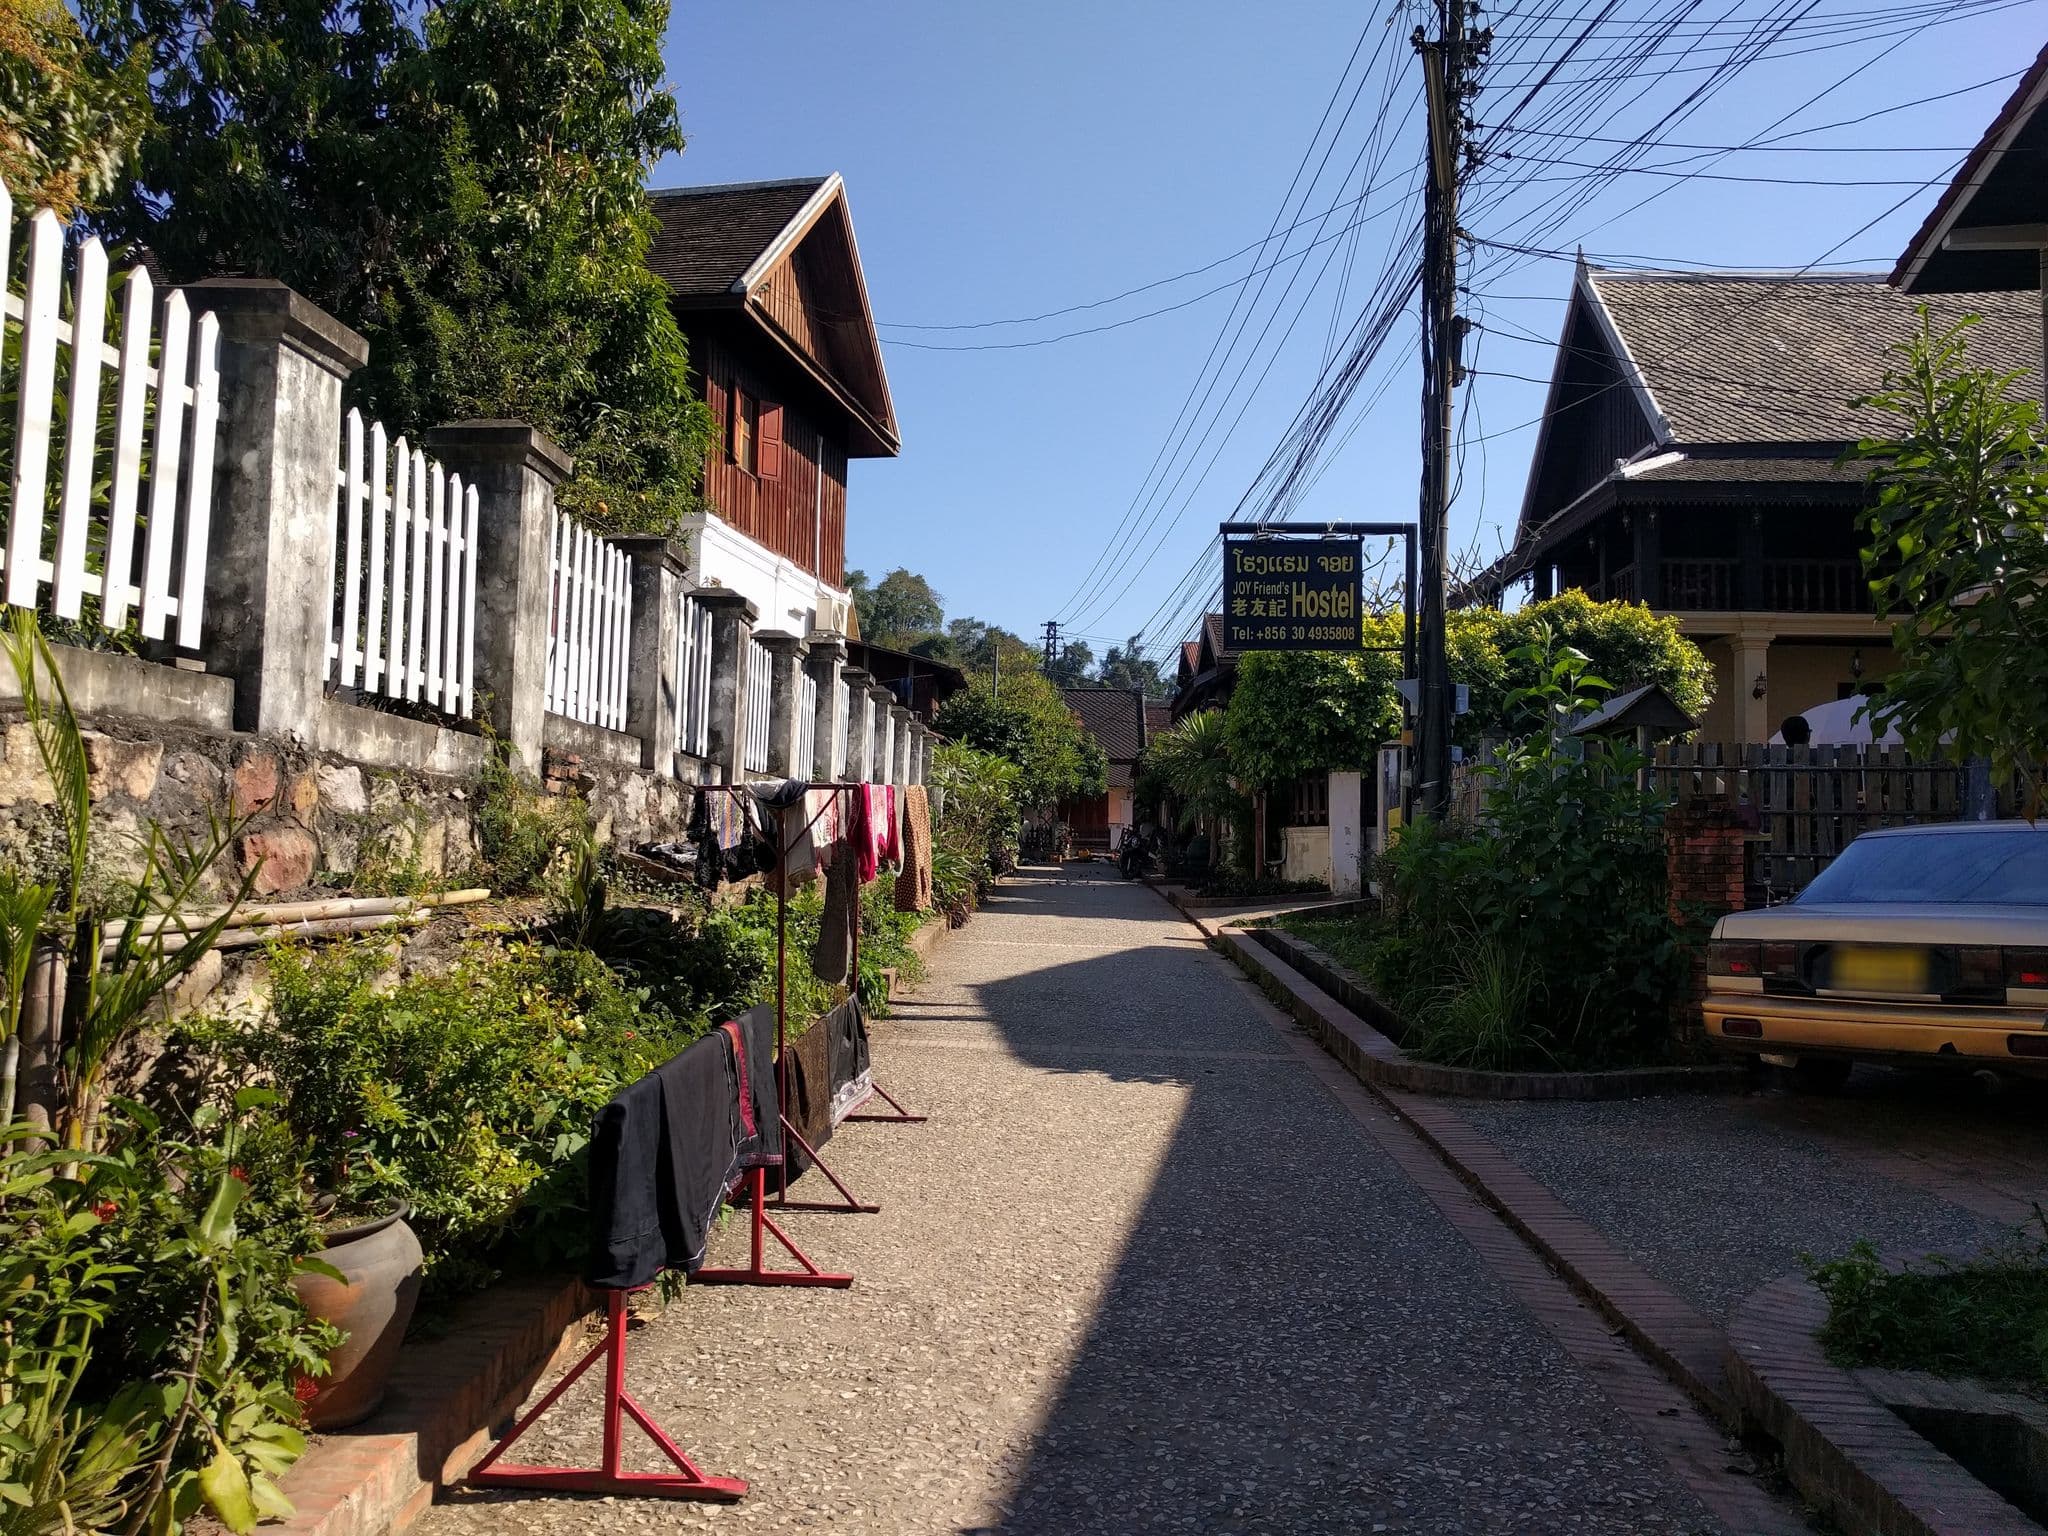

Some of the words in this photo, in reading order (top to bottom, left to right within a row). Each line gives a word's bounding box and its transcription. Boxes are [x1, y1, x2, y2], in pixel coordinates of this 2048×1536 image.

[1231, 597, 1287, 617] 老友記
[1233, 581, 1251, 595] JOY
[1253, 581, 1290, 595] Friend's
[1292, 581, 1355, 619] Hostel
[1232, 626, 1254, 640] Tel:
[1256, 626, 1287, 640] +856
[1292, 626, 1305, 640] 30
[1308, 626, 1355, 640] 4935808
